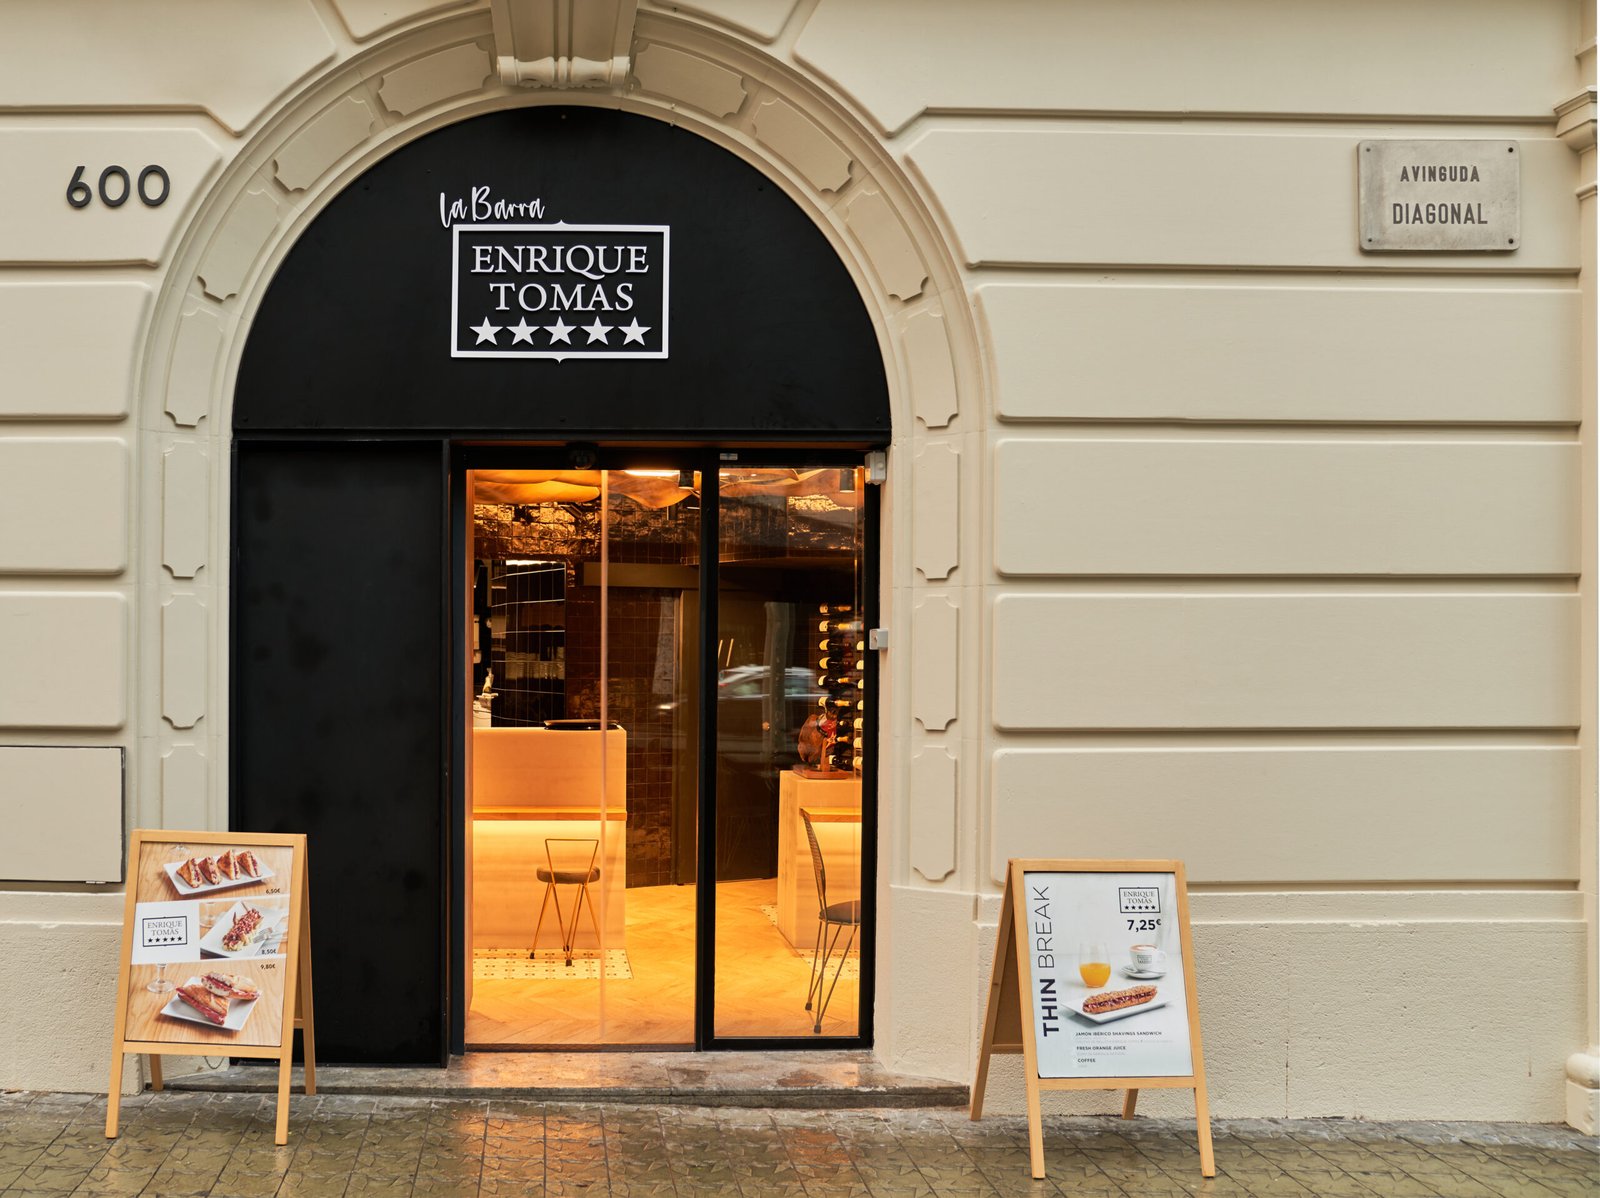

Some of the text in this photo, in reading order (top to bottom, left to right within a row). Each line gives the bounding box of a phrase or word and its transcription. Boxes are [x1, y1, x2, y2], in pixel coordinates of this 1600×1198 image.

[1400, 165, 1480, 182] AVINGUDA
[66, 164, 171, 209] 600
[471, 185, 546, 222] Barra
[1392, 203, 1488, 225] DIAGONAL
[470, 244, 650, 280] ENRIQUE
[489, 282, 634, 311] TOMAS
[1123, 890, 1155, 899] ENRIQUE
[147, 921, 183, 929] ENRIQUE
[1126, 918, 1162, 932] 7,25€
[1033, 886, 1060, 1037] THIN BREAK
